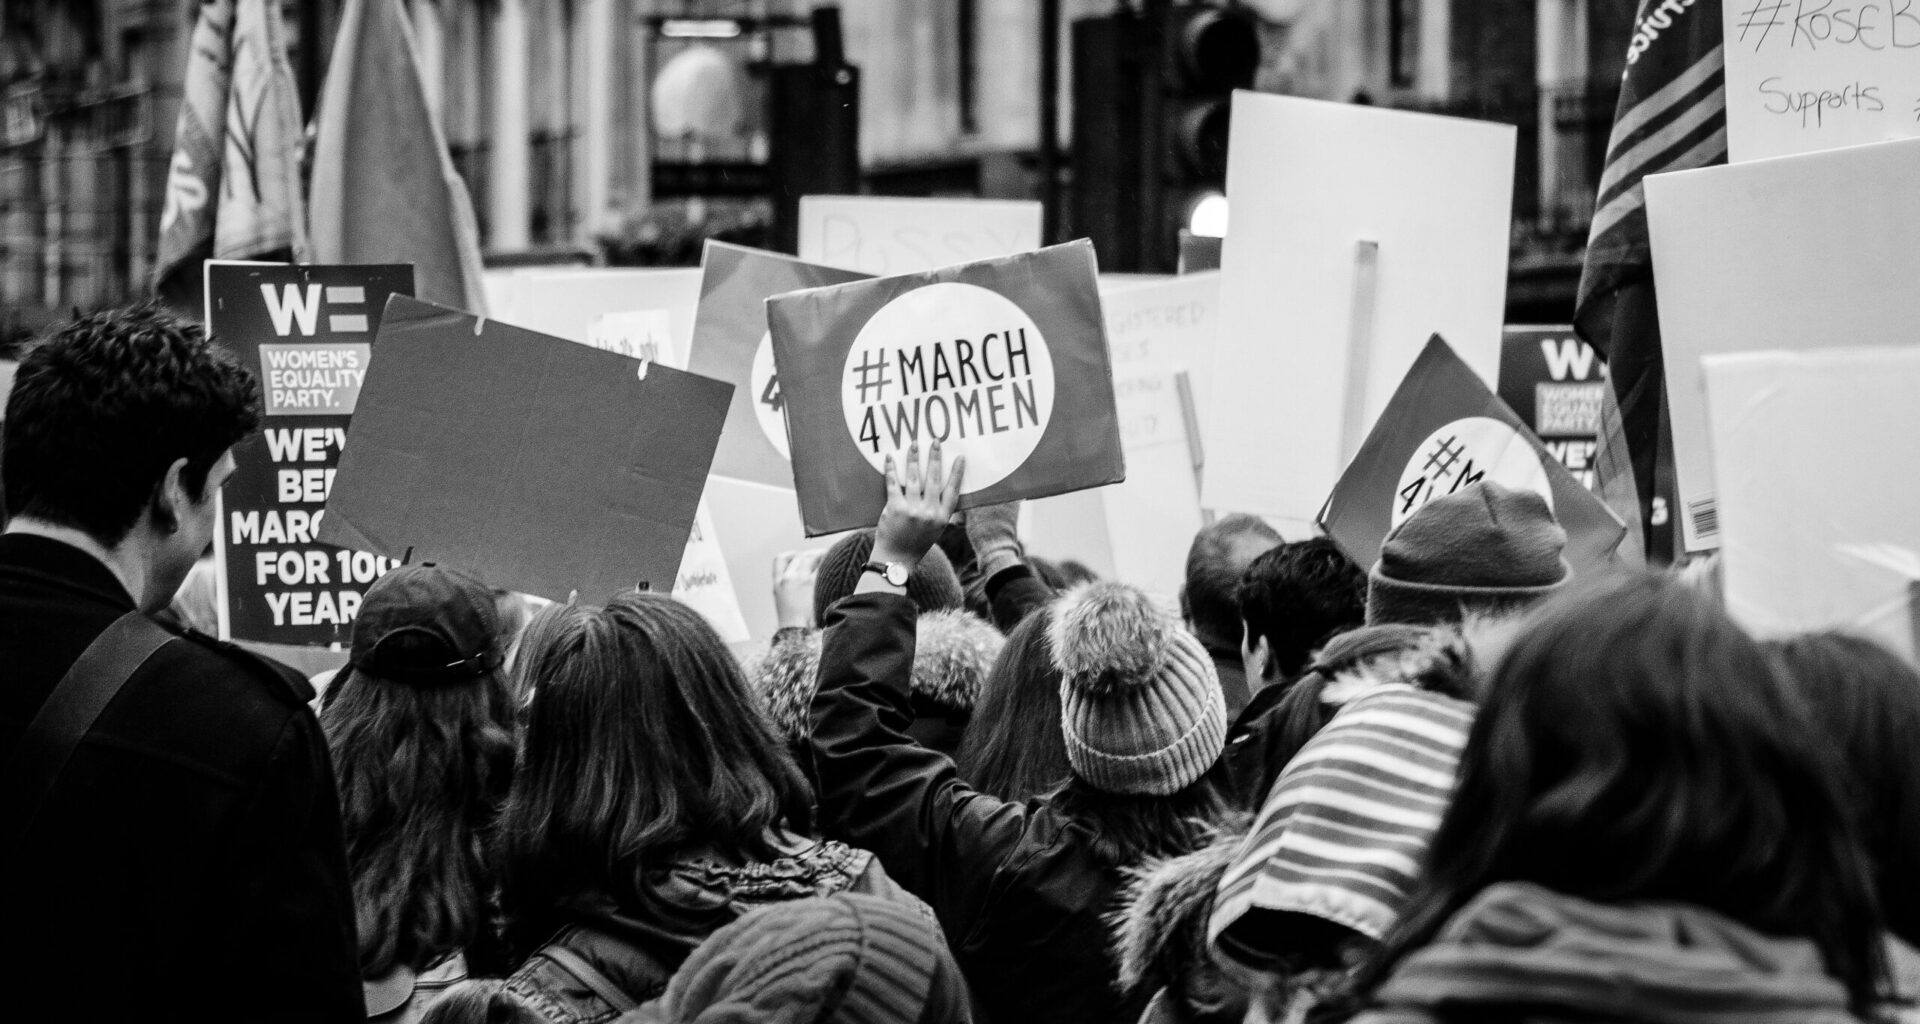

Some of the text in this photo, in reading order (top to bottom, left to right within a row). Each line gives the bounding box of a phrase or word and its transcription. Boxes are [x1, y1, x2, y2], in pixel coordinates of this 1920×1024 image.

[1759, 77, 1884, 128] Supports
[267, 350, 359, 369] WOMEN'S
[853, 328, 1031, 404] #MARCH
[270, 369, 365, 388] EQUALITY
[272, 389, 340, 408] PARTY.
[859, 379, 1039, 453] 4WOMEN
[256, 550, 330, 585] FOR
[264, 591, 363, 626] YEAR
